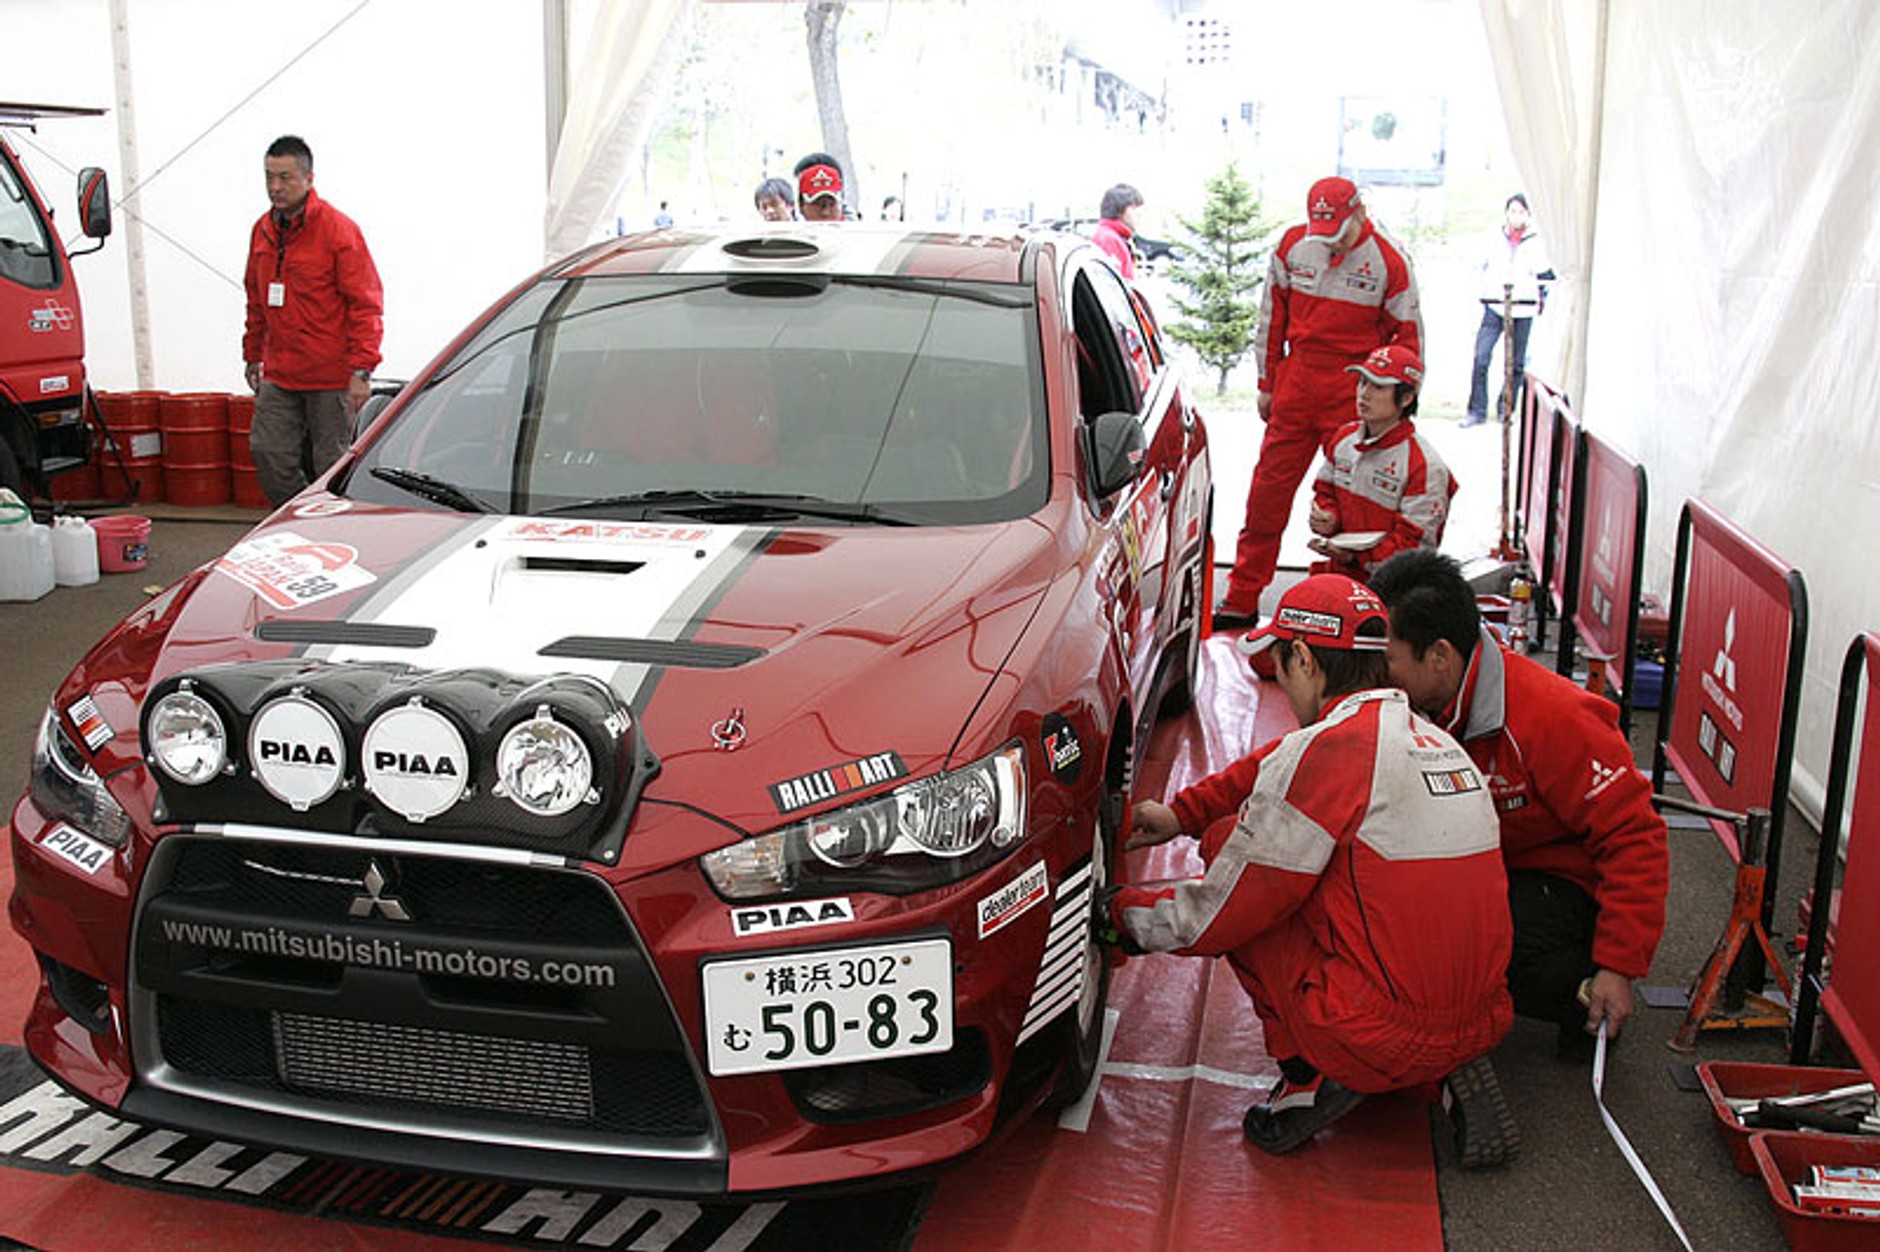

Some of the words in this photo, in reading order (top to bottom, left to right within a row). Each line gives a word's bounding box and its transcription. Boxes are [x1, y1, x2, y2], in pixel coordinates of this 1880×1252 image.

[513, 523, 709, 541] KATSU
[286, 575, 338, 599] 59
[260, 740, 337, 765] PIAA
[374, 751, 458, 776] PIAA
[777, 770, 837, 810] RALLI
[857, 753, 898, 785] ART
[47, 828, 104, 869] PIAA
[736, 901, 848, 932] PIAA
[162, 919, 616, 987] www.mitsubishi-motors.com
[723, 1023, 753, 1052] む
[761, 989, 940, 1061] 50-83
